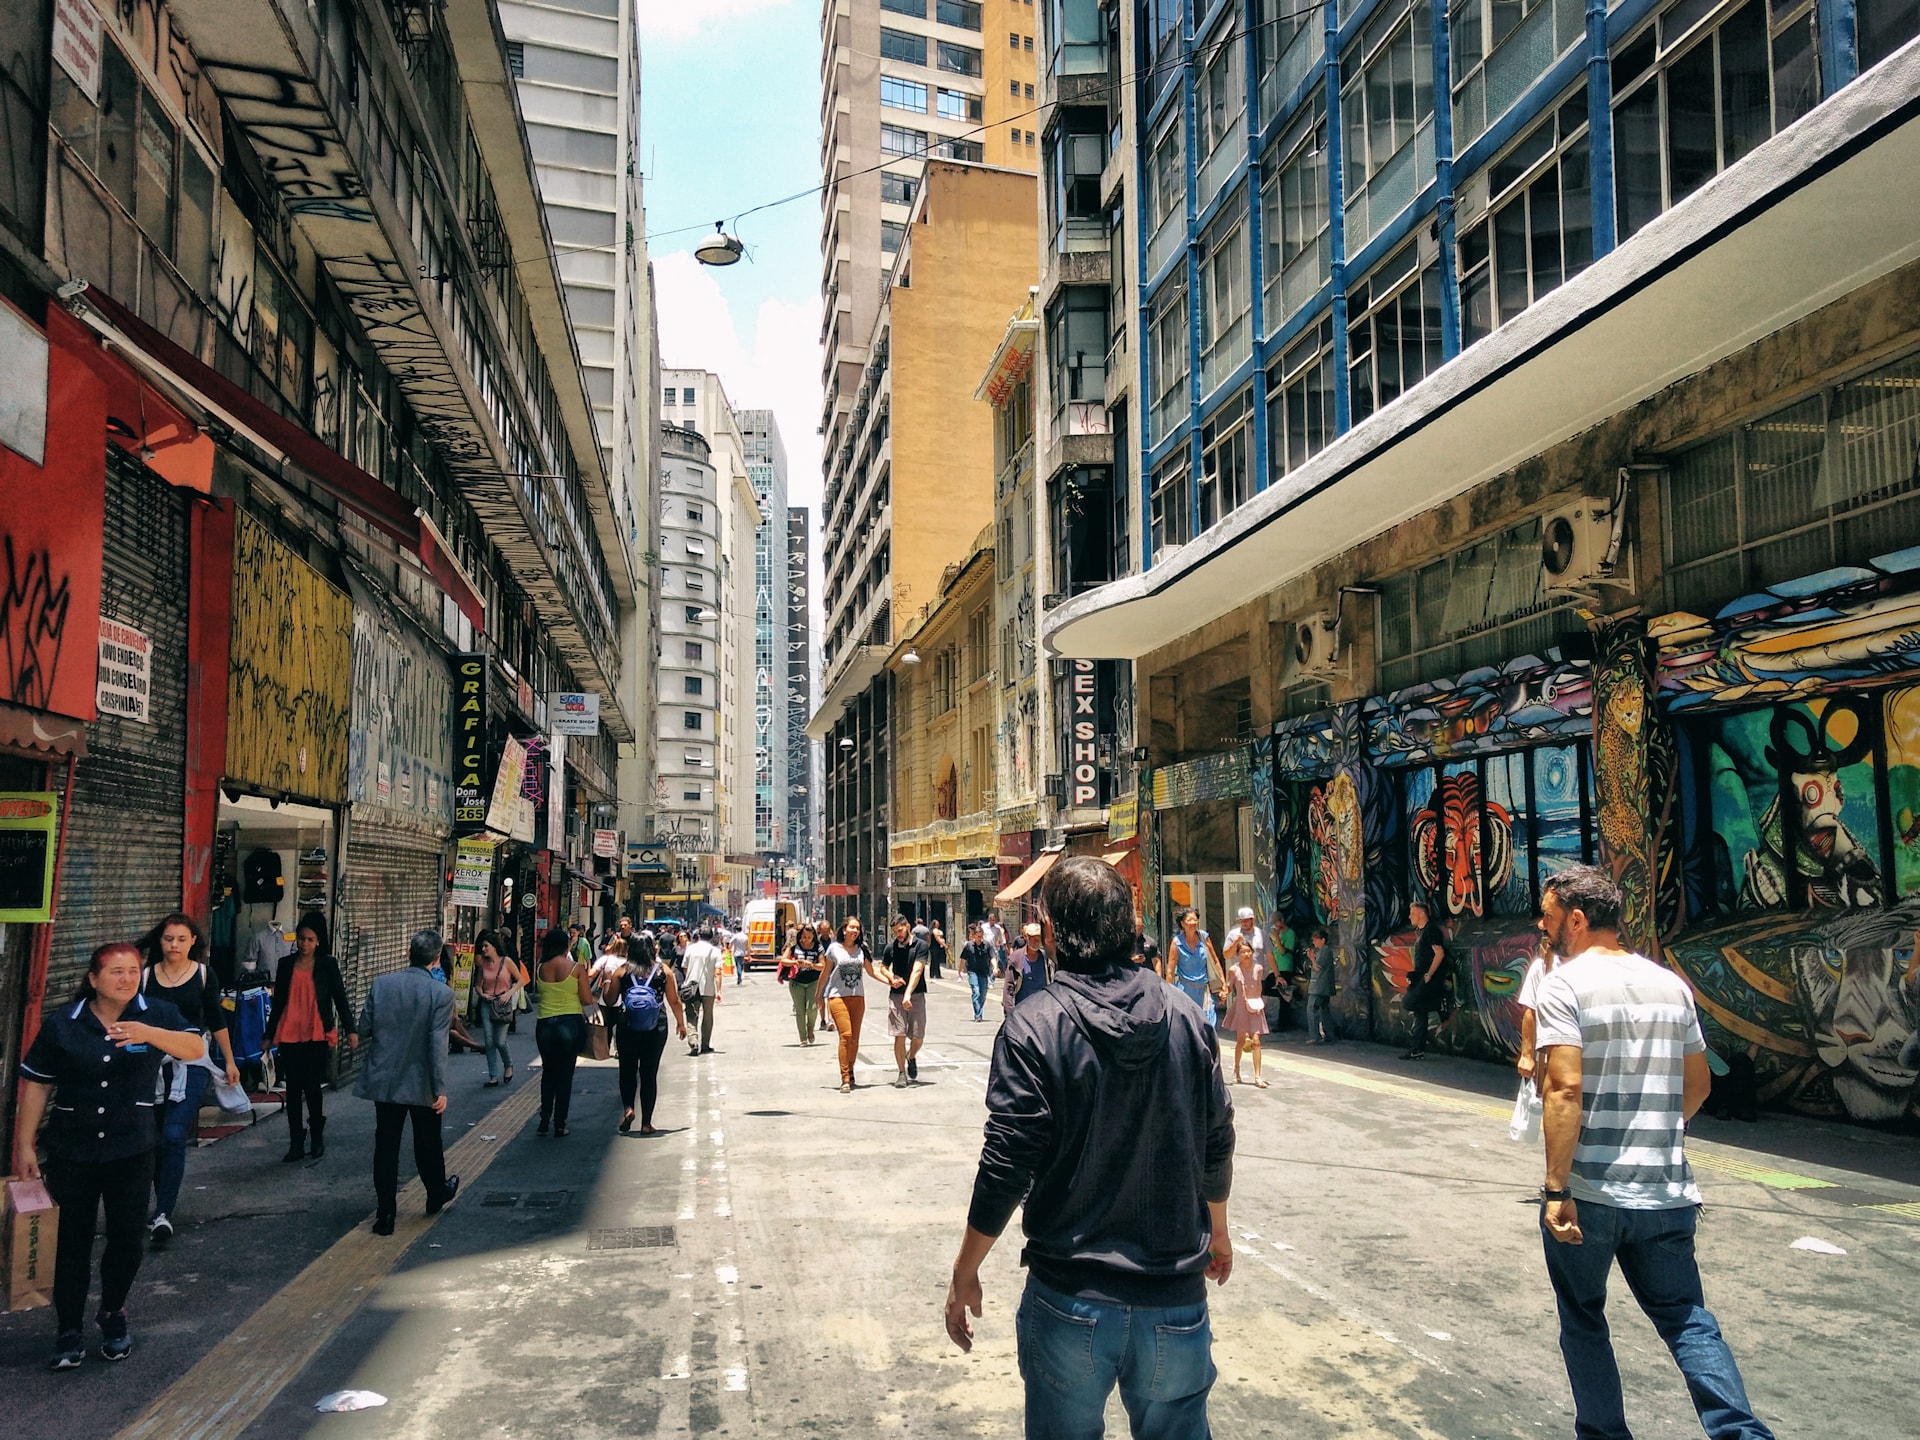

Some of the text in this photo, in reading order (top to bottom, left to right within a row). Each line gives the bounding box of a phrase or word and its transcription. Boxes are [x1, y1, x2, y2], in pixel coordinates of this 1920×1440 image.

[460, 662, 481, 786] GRÁFICA
[1074, 658, 1096, 805] SEX SHOP
[456, 787, 477, 797] Dom
[464, 797, 486, 807] José
[457, 809, 484, 820] 265
[455, 868, 483, 878] XEROX
